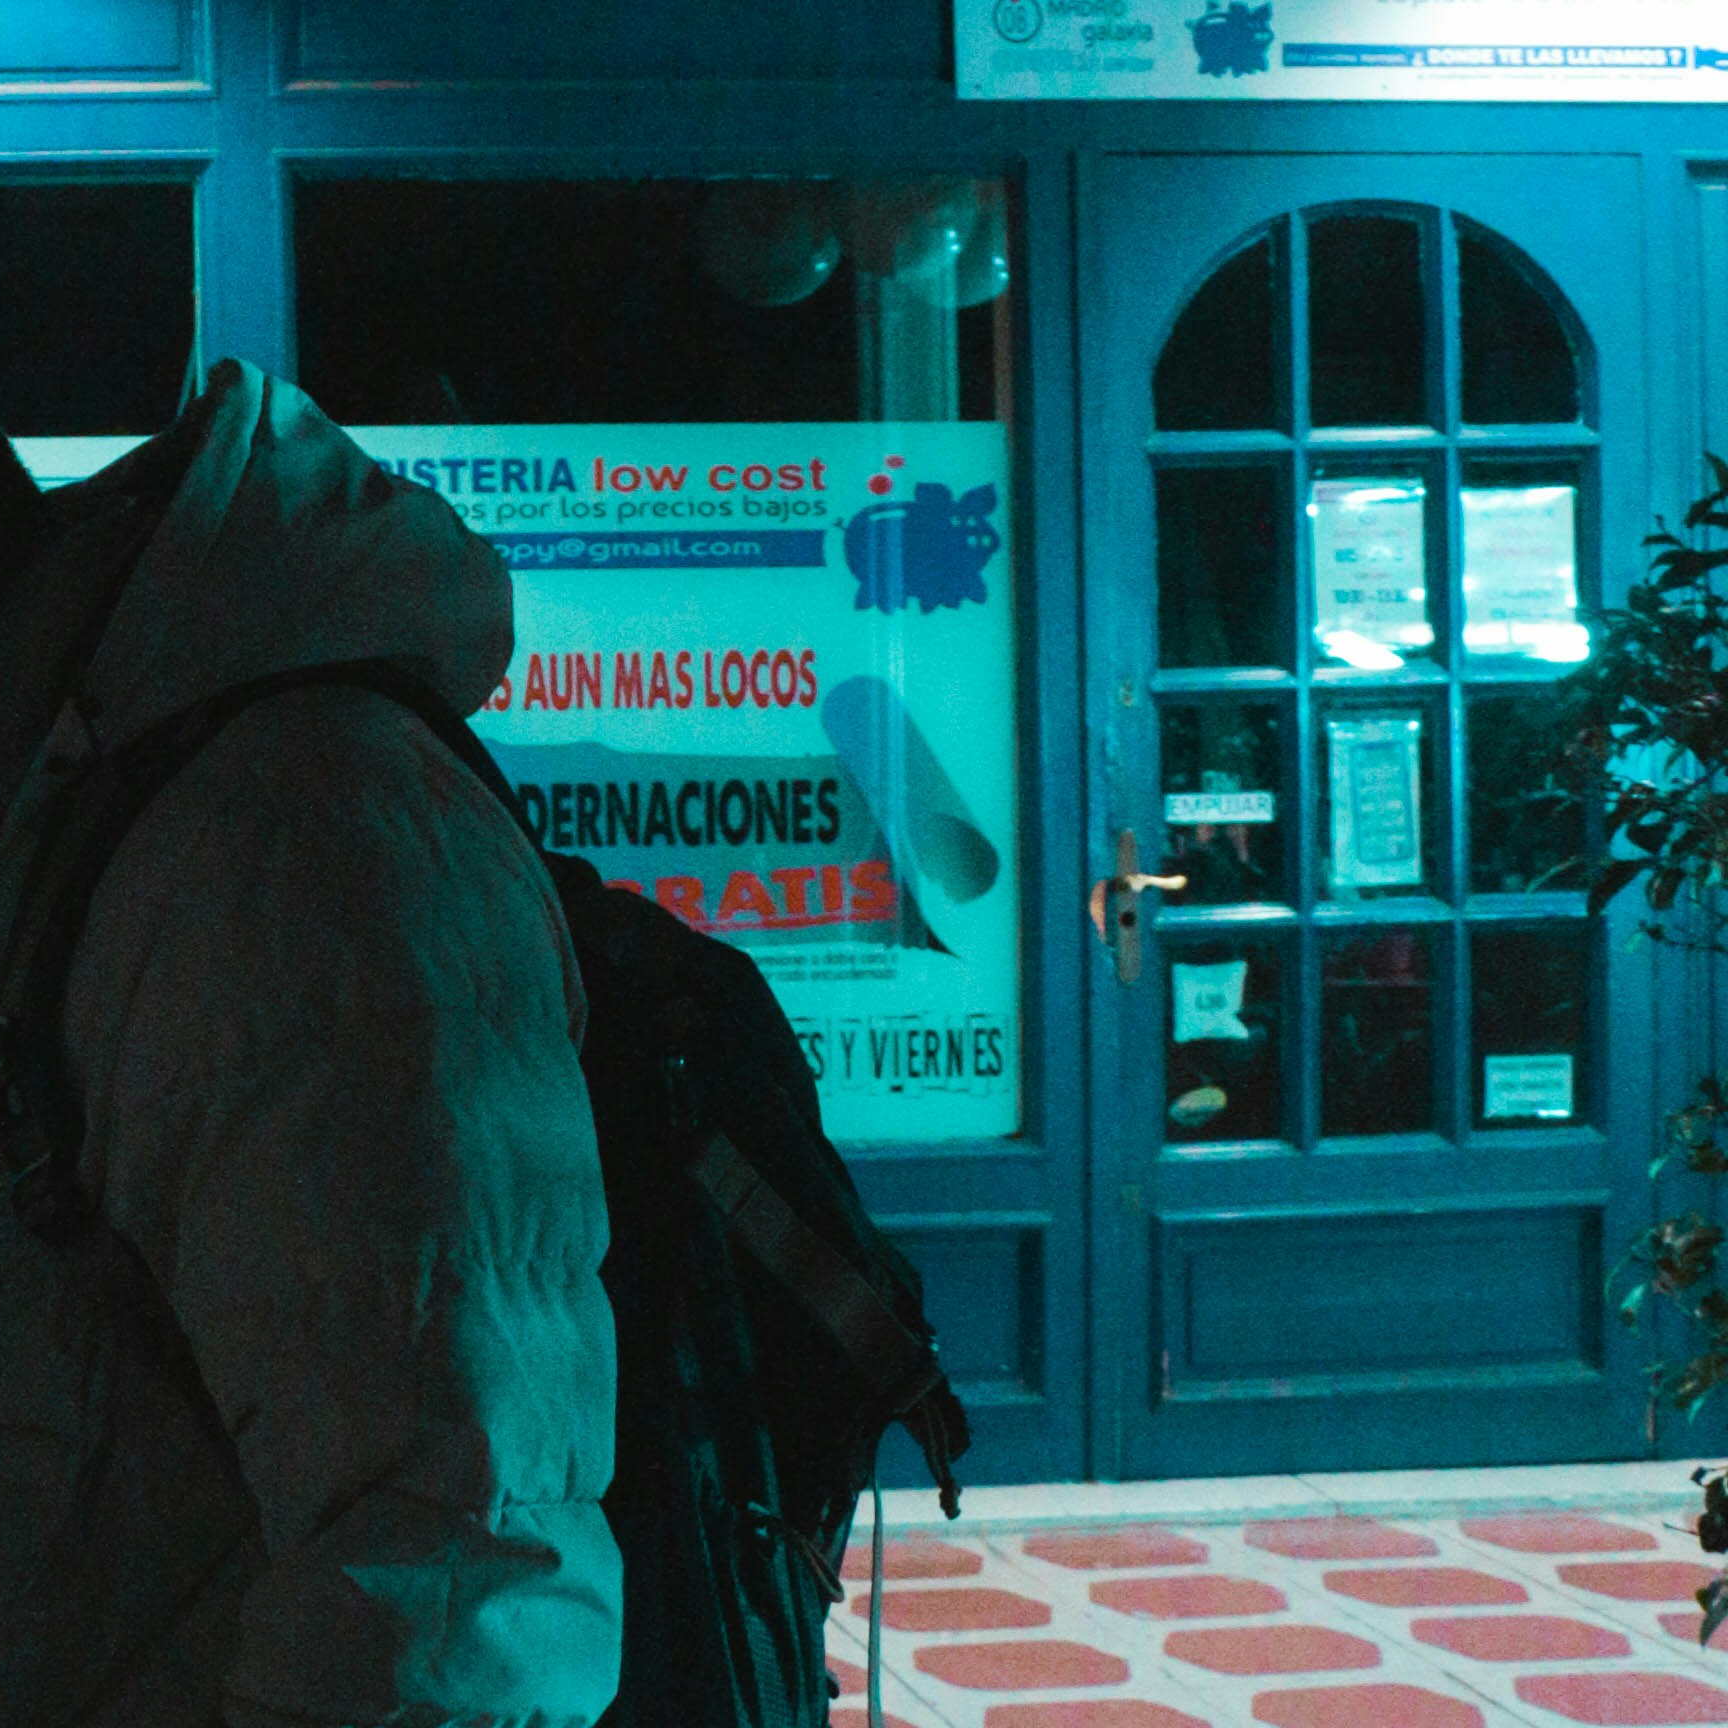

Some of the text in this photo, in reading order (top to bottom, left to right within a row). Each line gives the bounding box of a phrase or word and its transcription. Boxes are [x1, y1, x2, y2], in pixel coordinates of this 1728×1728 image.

[591, 455, 689, 494] low
[707, 455, 828, 493] cost
[496, 501, 552, 525] por
[559, 494, 609, 520] los
[616, 494, 734, 524] precios
[742, 493, 828, 524] bajos
[523, 650, 603, 712] AUN
[613, 649, 694, 710] MAS
[704, 648, 818, 709] LOCOS
[602, 859, 897, 924] RATIS
[839, 1029, 857, 1081] Y
[869, 1026, 1003, 1080] VIERNES
